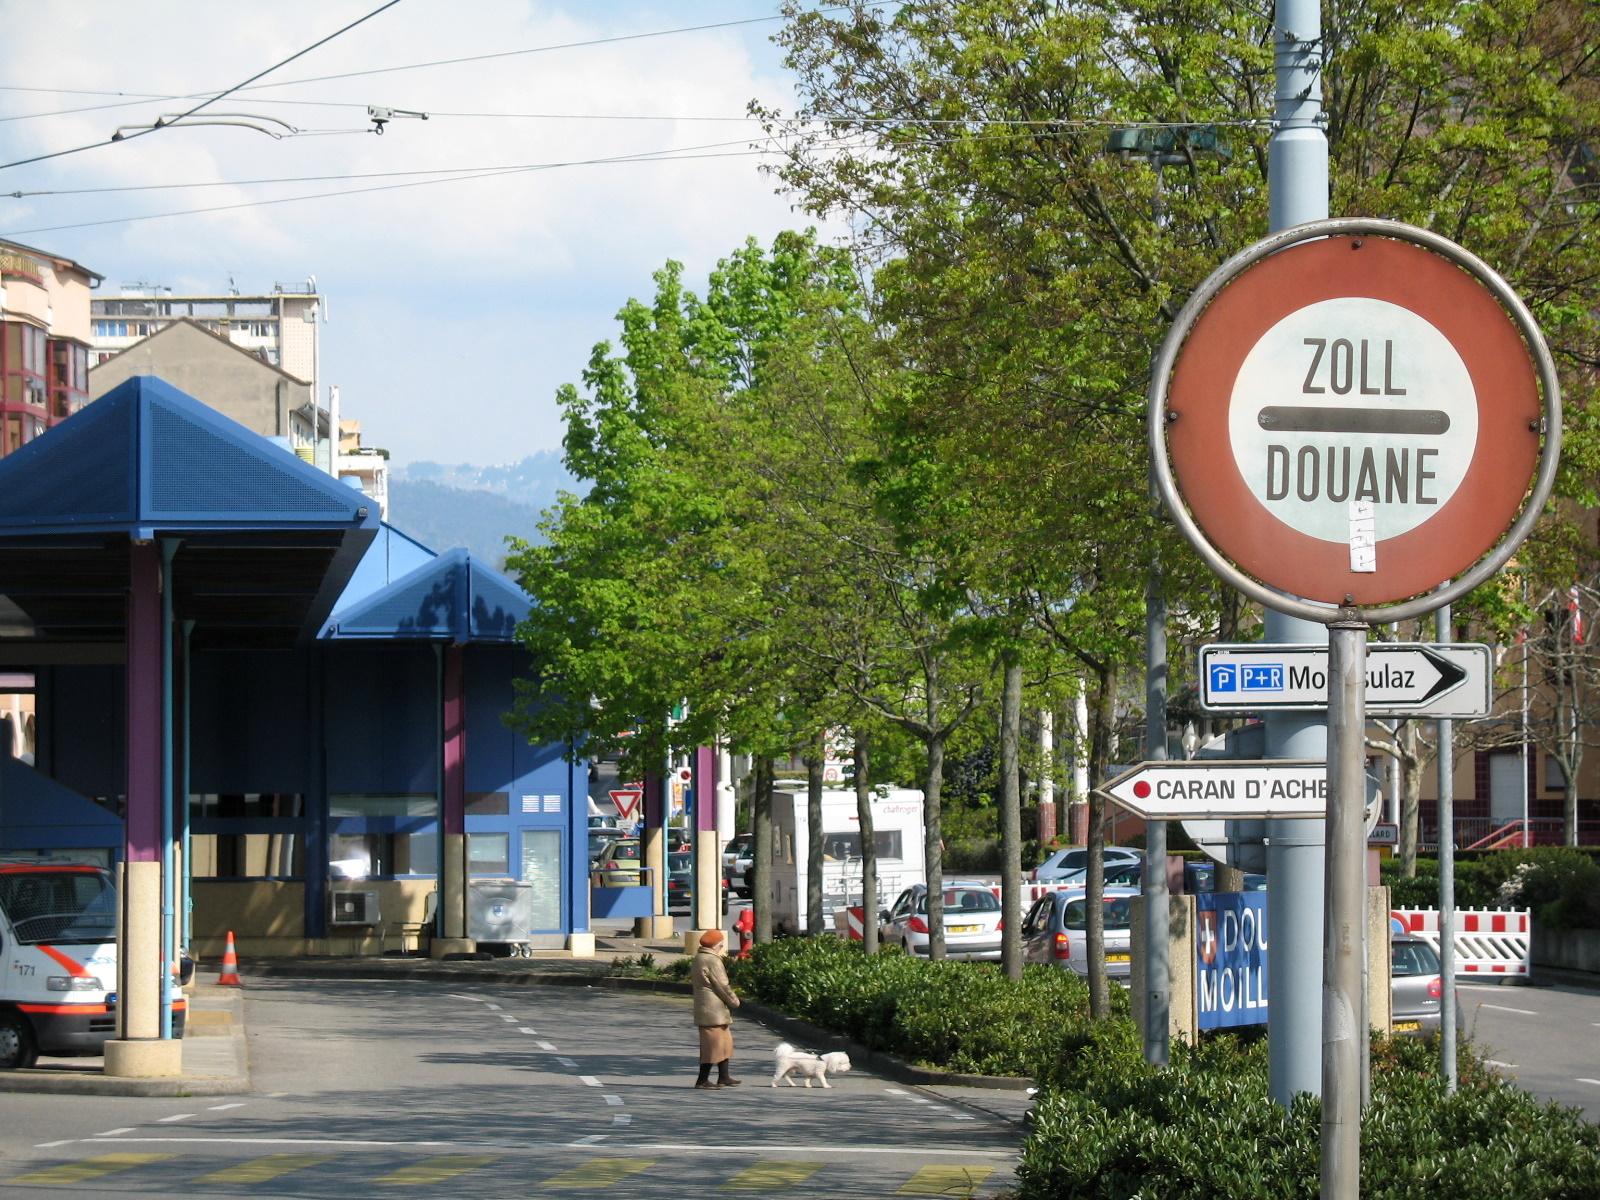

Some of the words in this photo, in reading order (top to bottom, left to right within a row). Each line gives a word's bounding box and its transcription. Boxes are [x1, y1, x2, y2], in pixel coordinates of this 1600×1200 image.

[1302, 337, 1407, 396] ZOLL
[1266, 444, 1439, 505] DOUANE
[1243, 668, 1281, 688] P+R
[1156, 780, 1235, 800] CARAN
[1245, 779, 1327, 799] D'ACHE
[19, 964, 35, 977] 171
